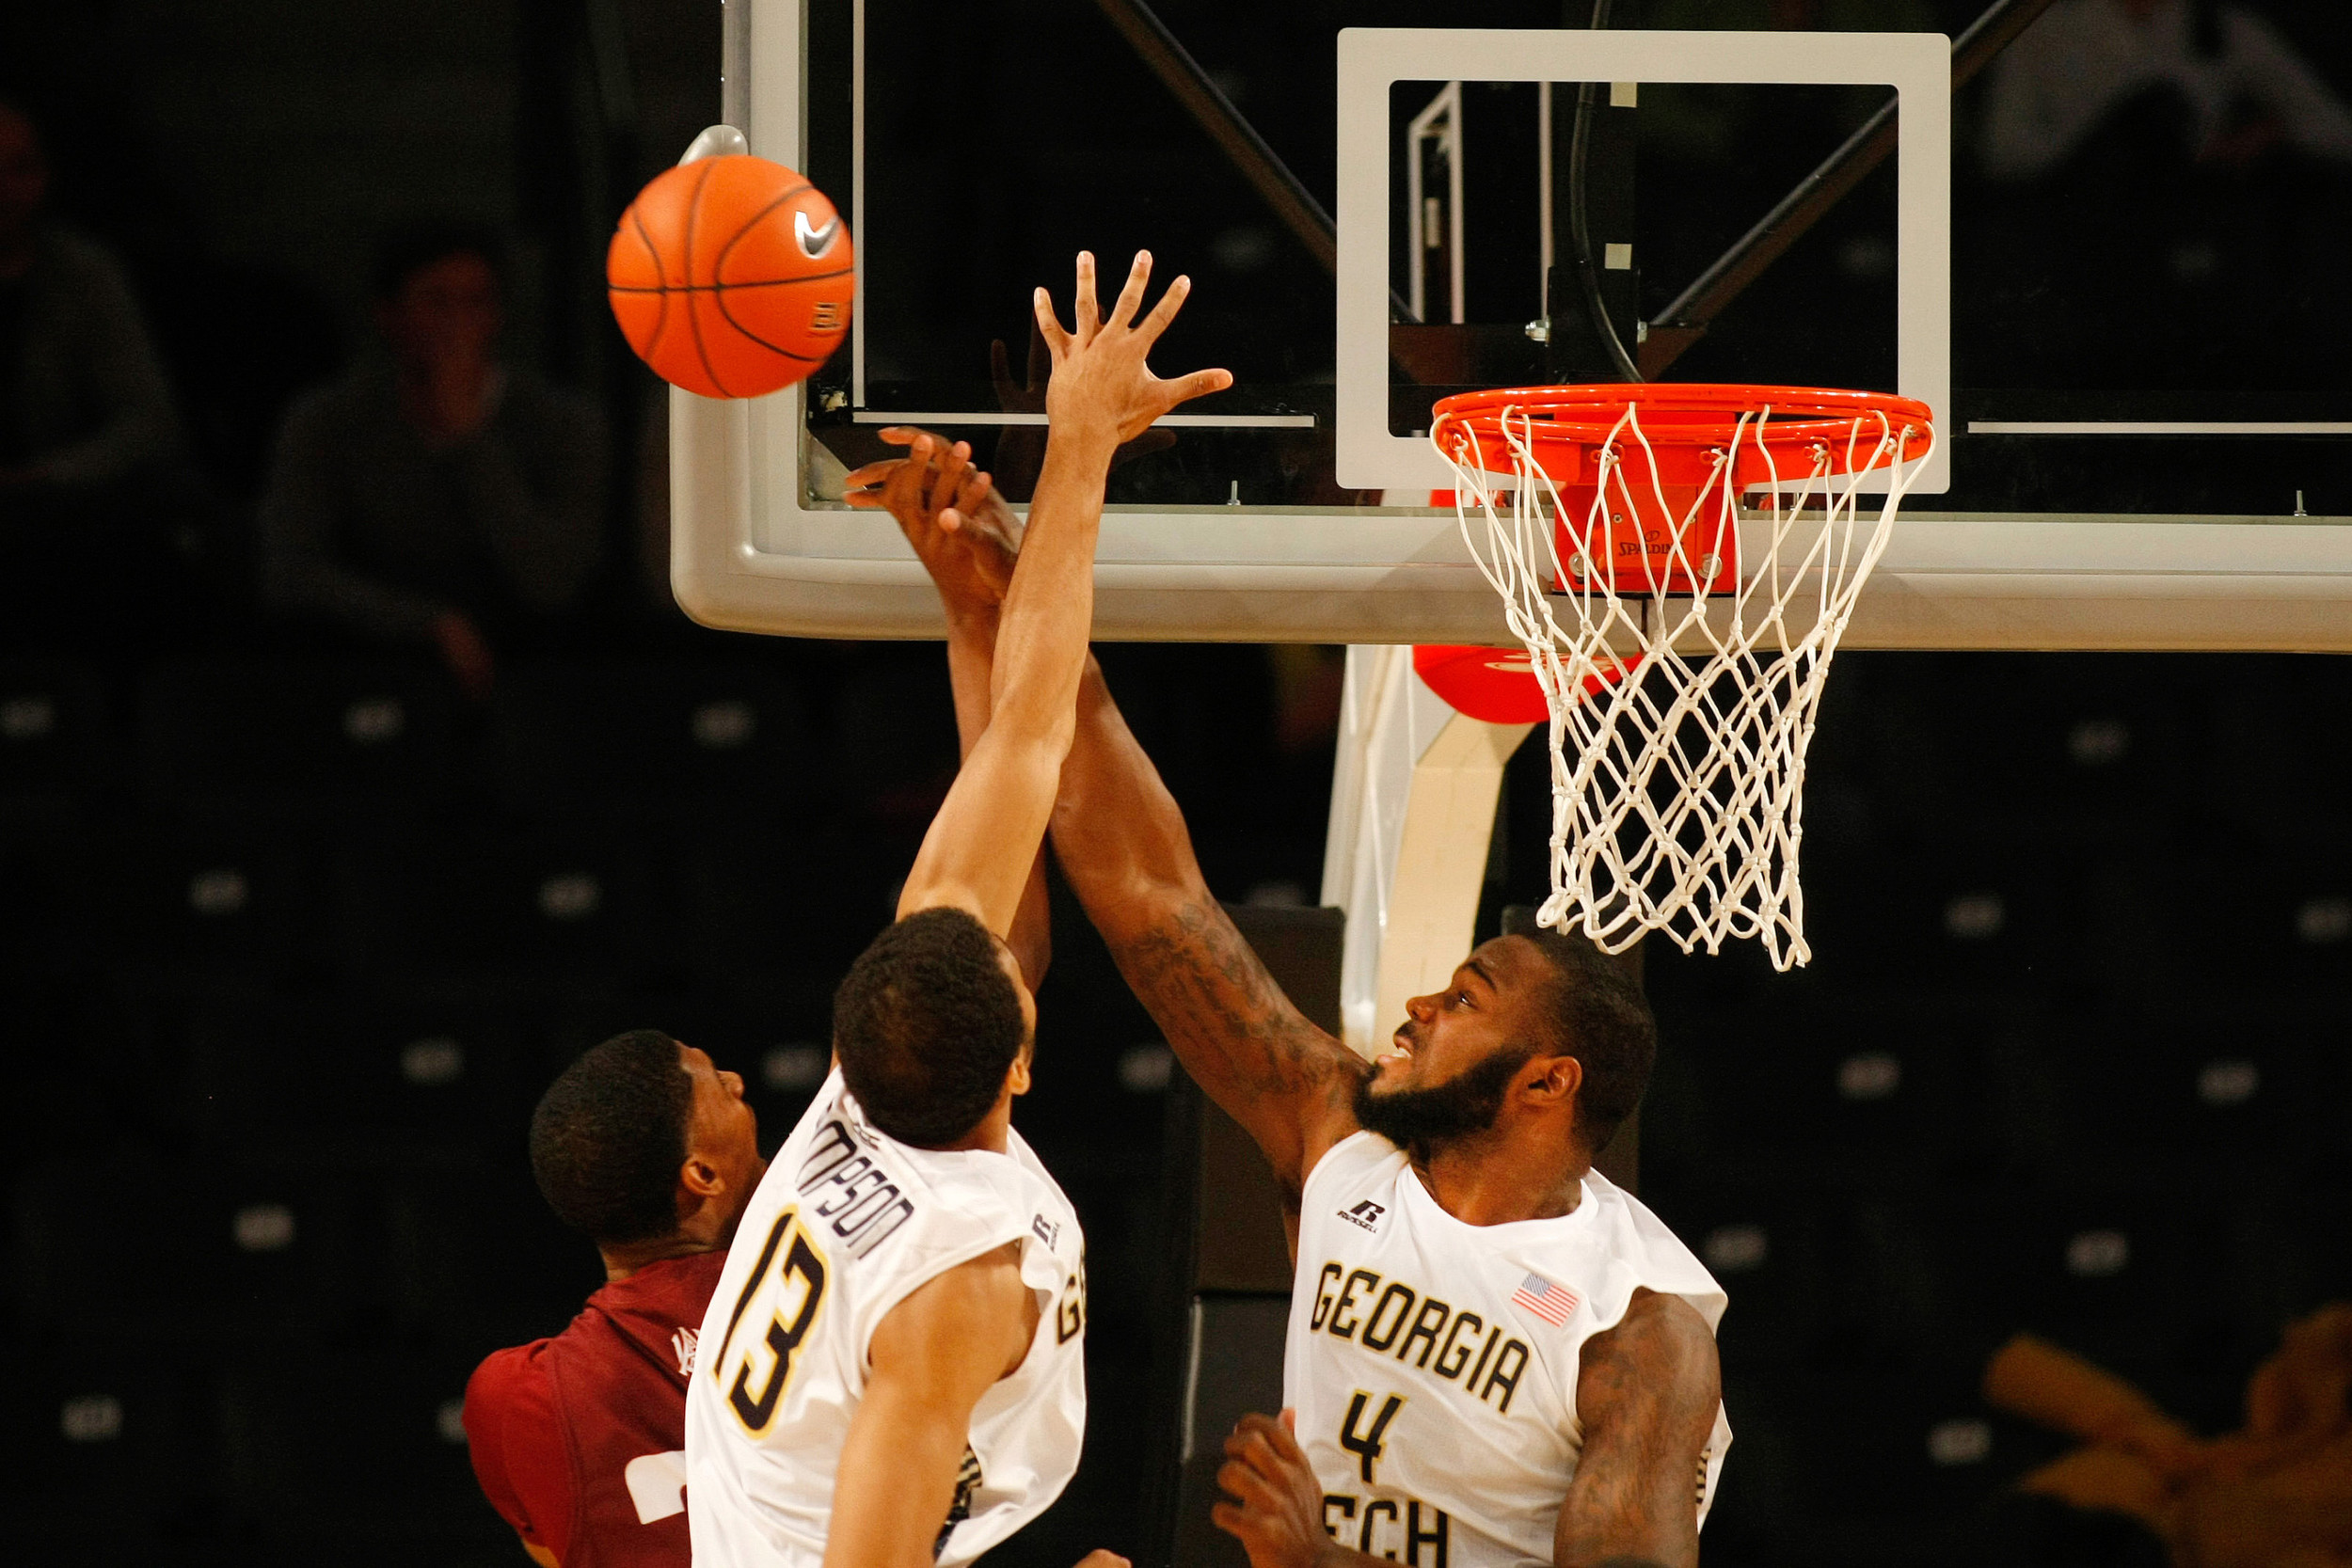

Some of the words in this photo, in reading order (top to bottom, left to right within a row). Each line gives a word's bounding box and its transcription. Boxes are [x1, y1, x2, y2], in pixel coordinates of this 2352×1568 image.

[1619, 542, 1684, 556] SPALDIN
[712, 1203, 829, 1440] 13
[1310, 1261, 1530, 1414] GEORGIA
[1340, 1388, 1409, 1485] 4
[1323, 1494, 1449, 1568] ECH
